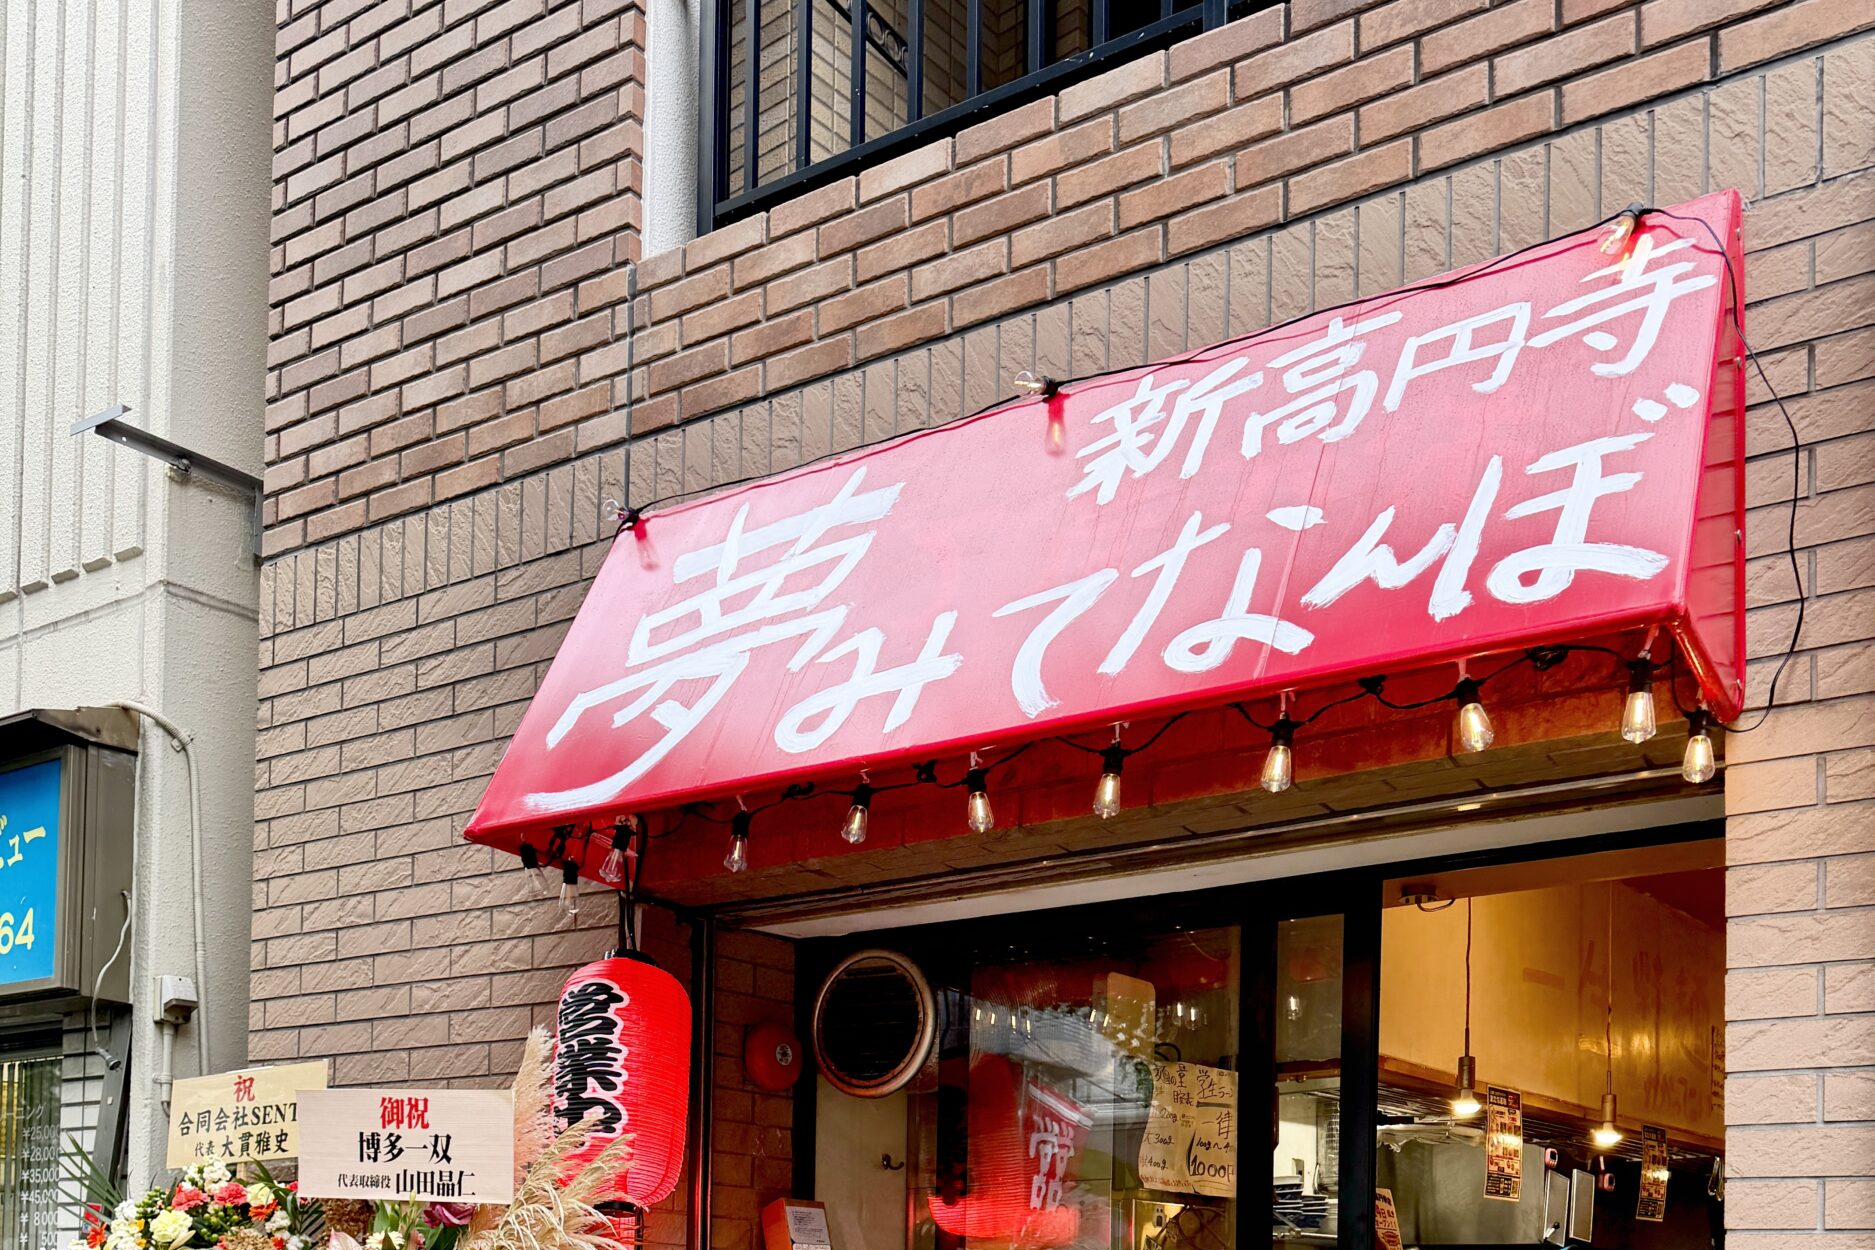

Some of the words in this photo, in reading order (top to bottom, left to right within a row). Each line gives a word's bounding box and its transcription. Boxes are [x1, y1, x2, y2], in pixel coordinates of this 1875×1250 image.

[1066, 235, 1719, 506] 新高円寺
[524, 383, 1702, 813] 夢みてなんぼ
[233, 1075, 256, 1102] 祝
[380, 1096, 430, 1130] 御祝
[195, 1140, 215, 1158] 代表
[221, 1128, 289, 1158] 大貫雅史
[358, 1131, 453, 1165] 博多一双
[338, 1173, 391, 1190] 代表取締役
[396, 1169, 477, 1198] 山田晶仁
